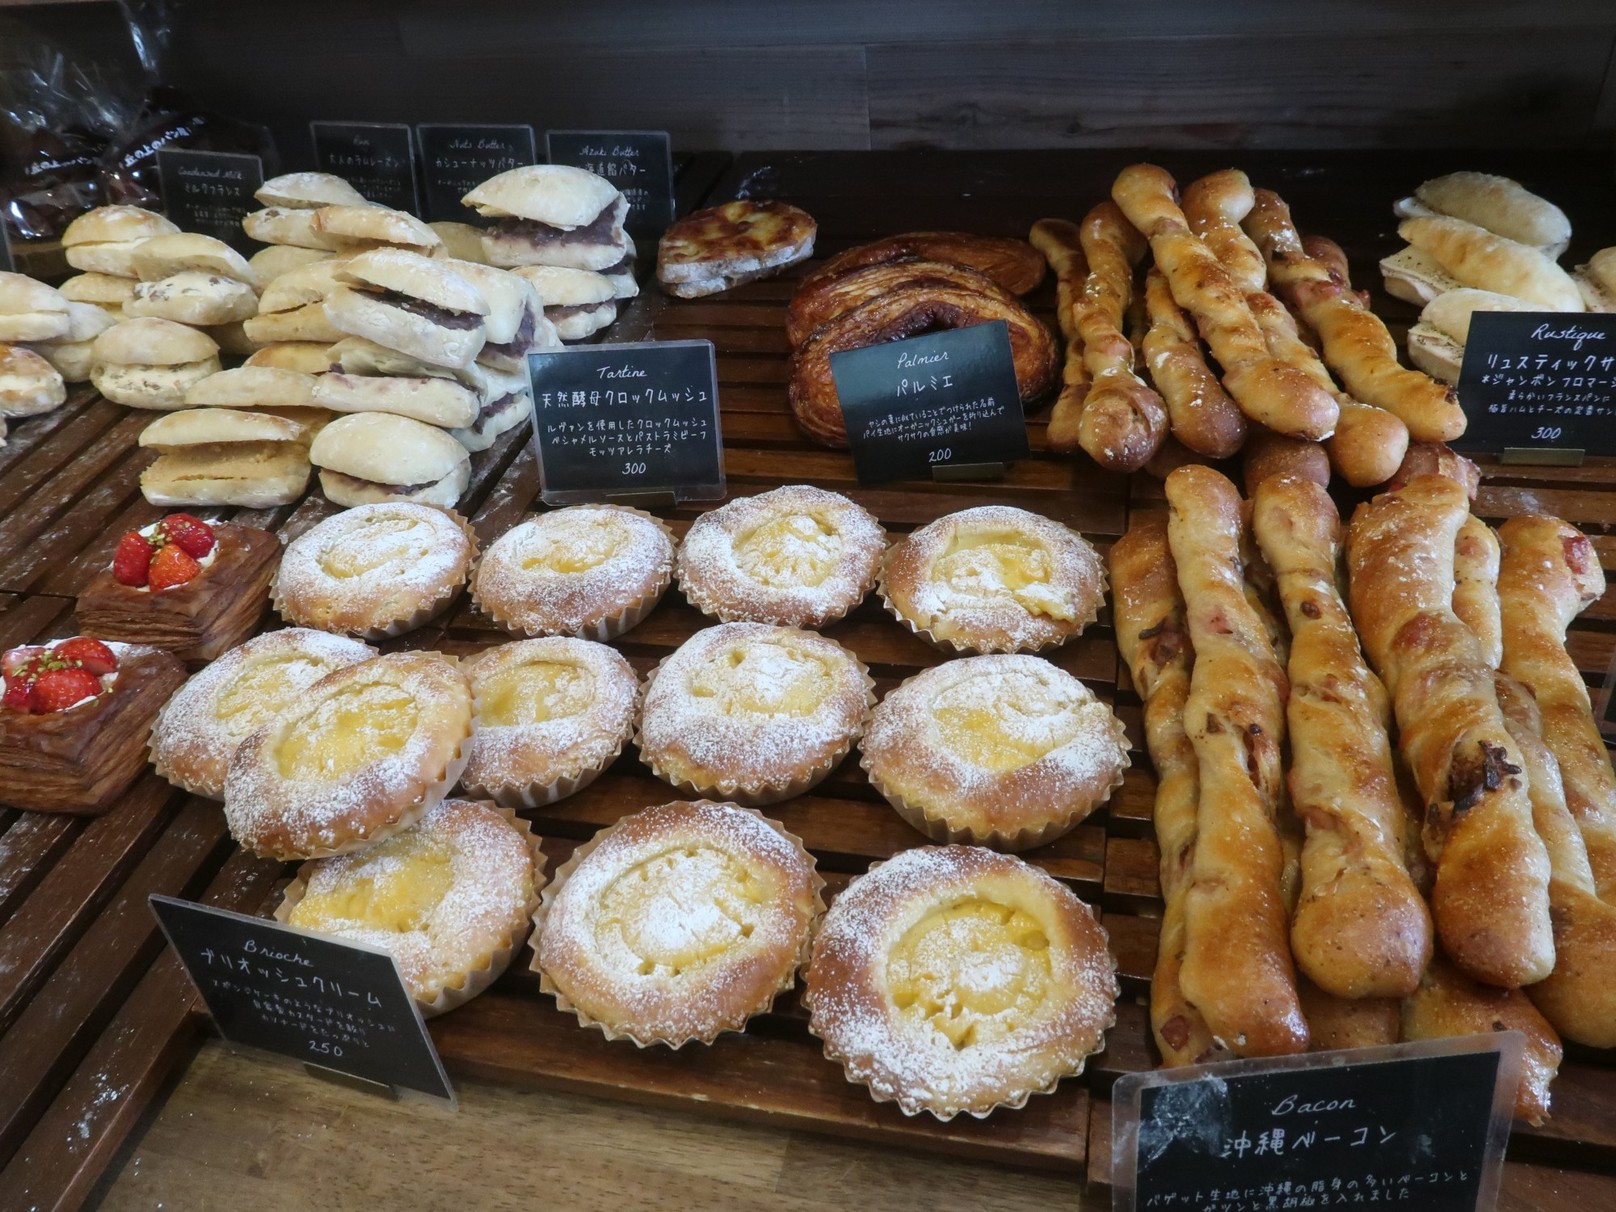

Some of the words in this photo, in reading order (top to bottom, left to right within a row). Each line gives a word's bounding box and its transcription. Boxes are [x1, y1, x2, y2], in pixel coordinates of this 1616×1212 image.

[612, 145, 640, 157] Butter
[1530, 323, 1608, 351] Rustique
[896, 350, 951, 370] Palmier
[596, 364, 648, 379] Tartine
[896, 374, 953, 397] パルミエ
[541, 385, 708, 409] 天然酵母クロックムッシュ
[546, 417, 708, 434] ルヴァンを使用したクロックムッシュ
[1530, 426, 1562, 440] 300
[928, 447, 952, 463] 200
[621, 462, 647, 475] 300
[243, 939, 315, 968] Brioche
[200, 948, 382, 1008] ブリオッシュクリーム
[308, 1040, 343, 1057] 250
[1271, 1094, 1359, 1116] Bacon
[1222, 1126, 1399, 1159] 沖縄ベーコン
